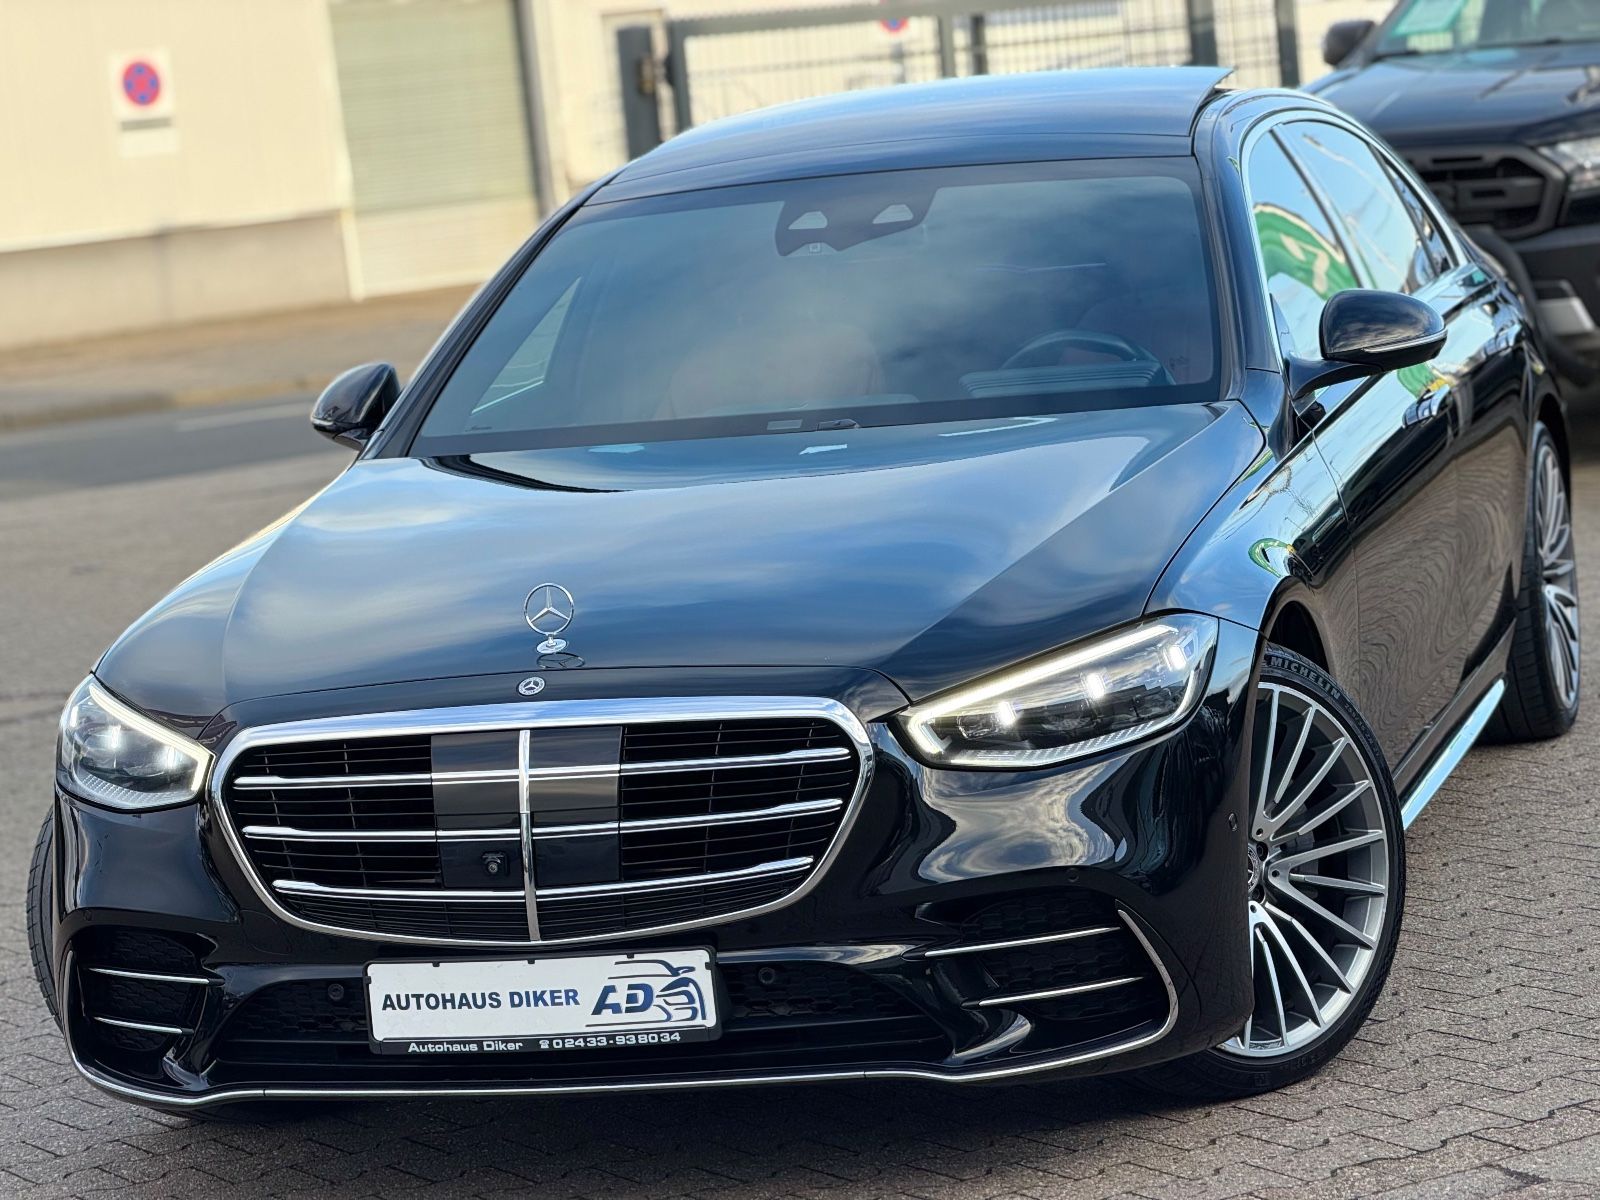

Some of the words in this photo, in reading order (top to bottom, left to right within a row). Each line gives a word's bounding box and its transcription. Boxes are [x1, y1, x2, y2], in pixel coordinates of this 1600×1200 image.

[1270, 656, 1341, 700] MICHELIN
[382, 992, 501, 1010] AUTOHAUS
[509, 988, 580, 1007] DIKER
[591, 984, 654, 1015] AD
[408, 1042, 478, 1052] Autohaus
[483, 1041, 523, 1051] Diker
[553, 1032, 681, 1048] 02433-938034
